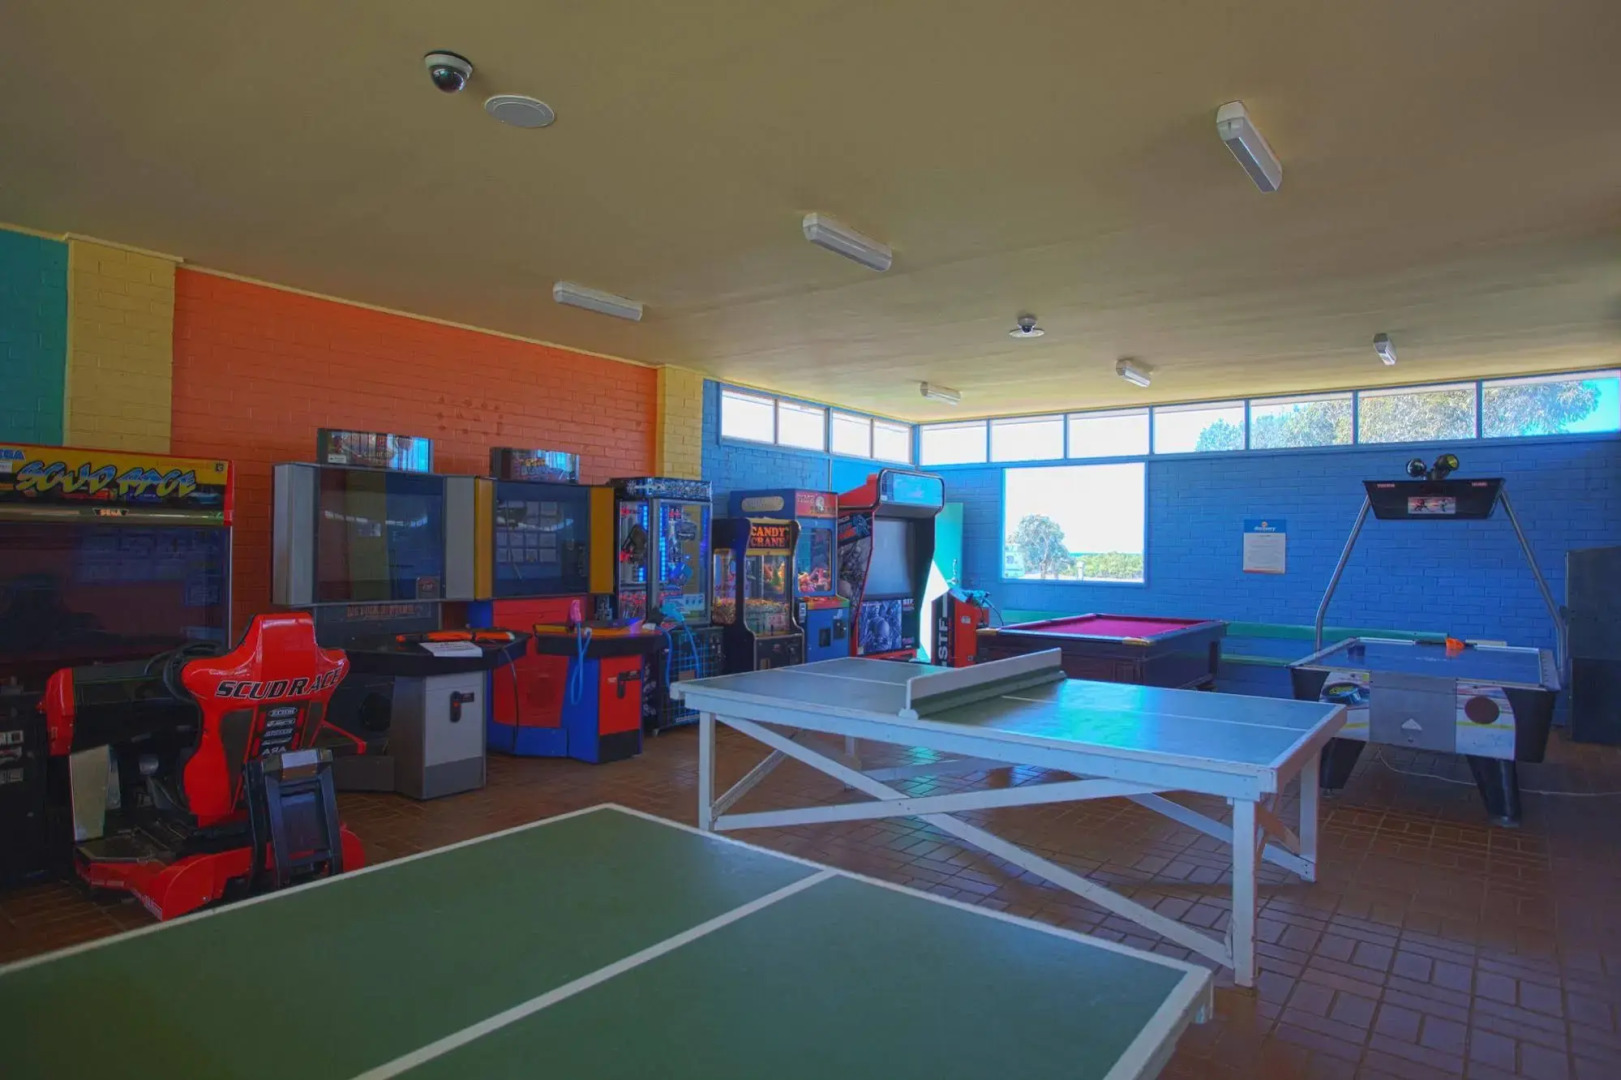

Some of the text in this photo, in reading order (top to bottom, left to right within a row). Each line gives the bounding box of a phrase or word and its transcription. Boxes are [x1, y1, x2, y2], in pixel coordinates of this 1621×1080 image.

[15, 460, 197, 498] SCUD RACE
[750, 525, 786, 537] CANDY
[750, 537, 786, 547] CRANE
[938, 617, 948, 660] STF
[216, 667, 343, 700] SCUD RACE
